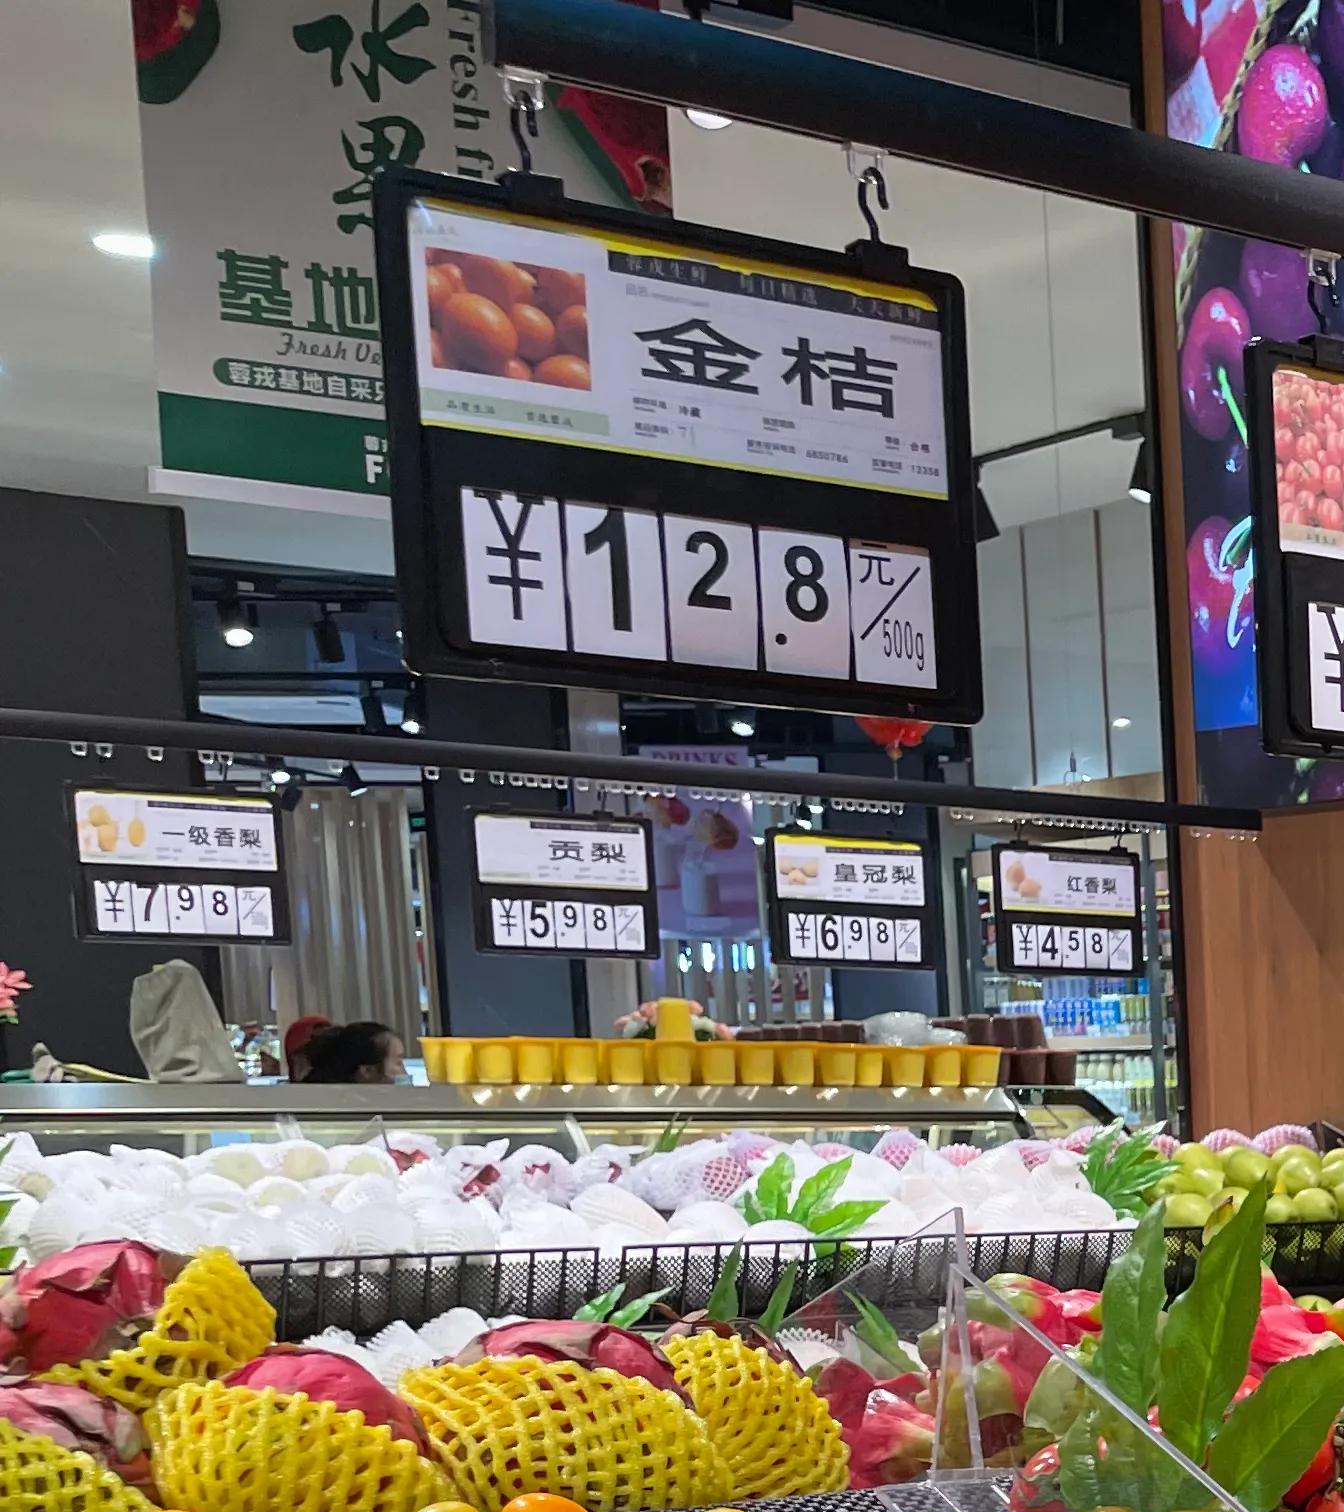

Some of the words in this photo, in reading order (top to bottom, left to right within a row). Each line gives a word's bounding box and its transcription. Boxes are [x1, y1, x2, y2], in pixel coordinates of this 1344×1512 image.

[217, 249, 380, 340] 基地
[276, 332, 347, 362] Fresh
[633, 318, 897, 419] 金桔
[162, 825, 262, 849] 一级香梨
[548, 840, 626, 864] 贡梨
[833, 863, 917, 885] 皇冠梨
[1067, 875, 1118, 895] 红香梨
